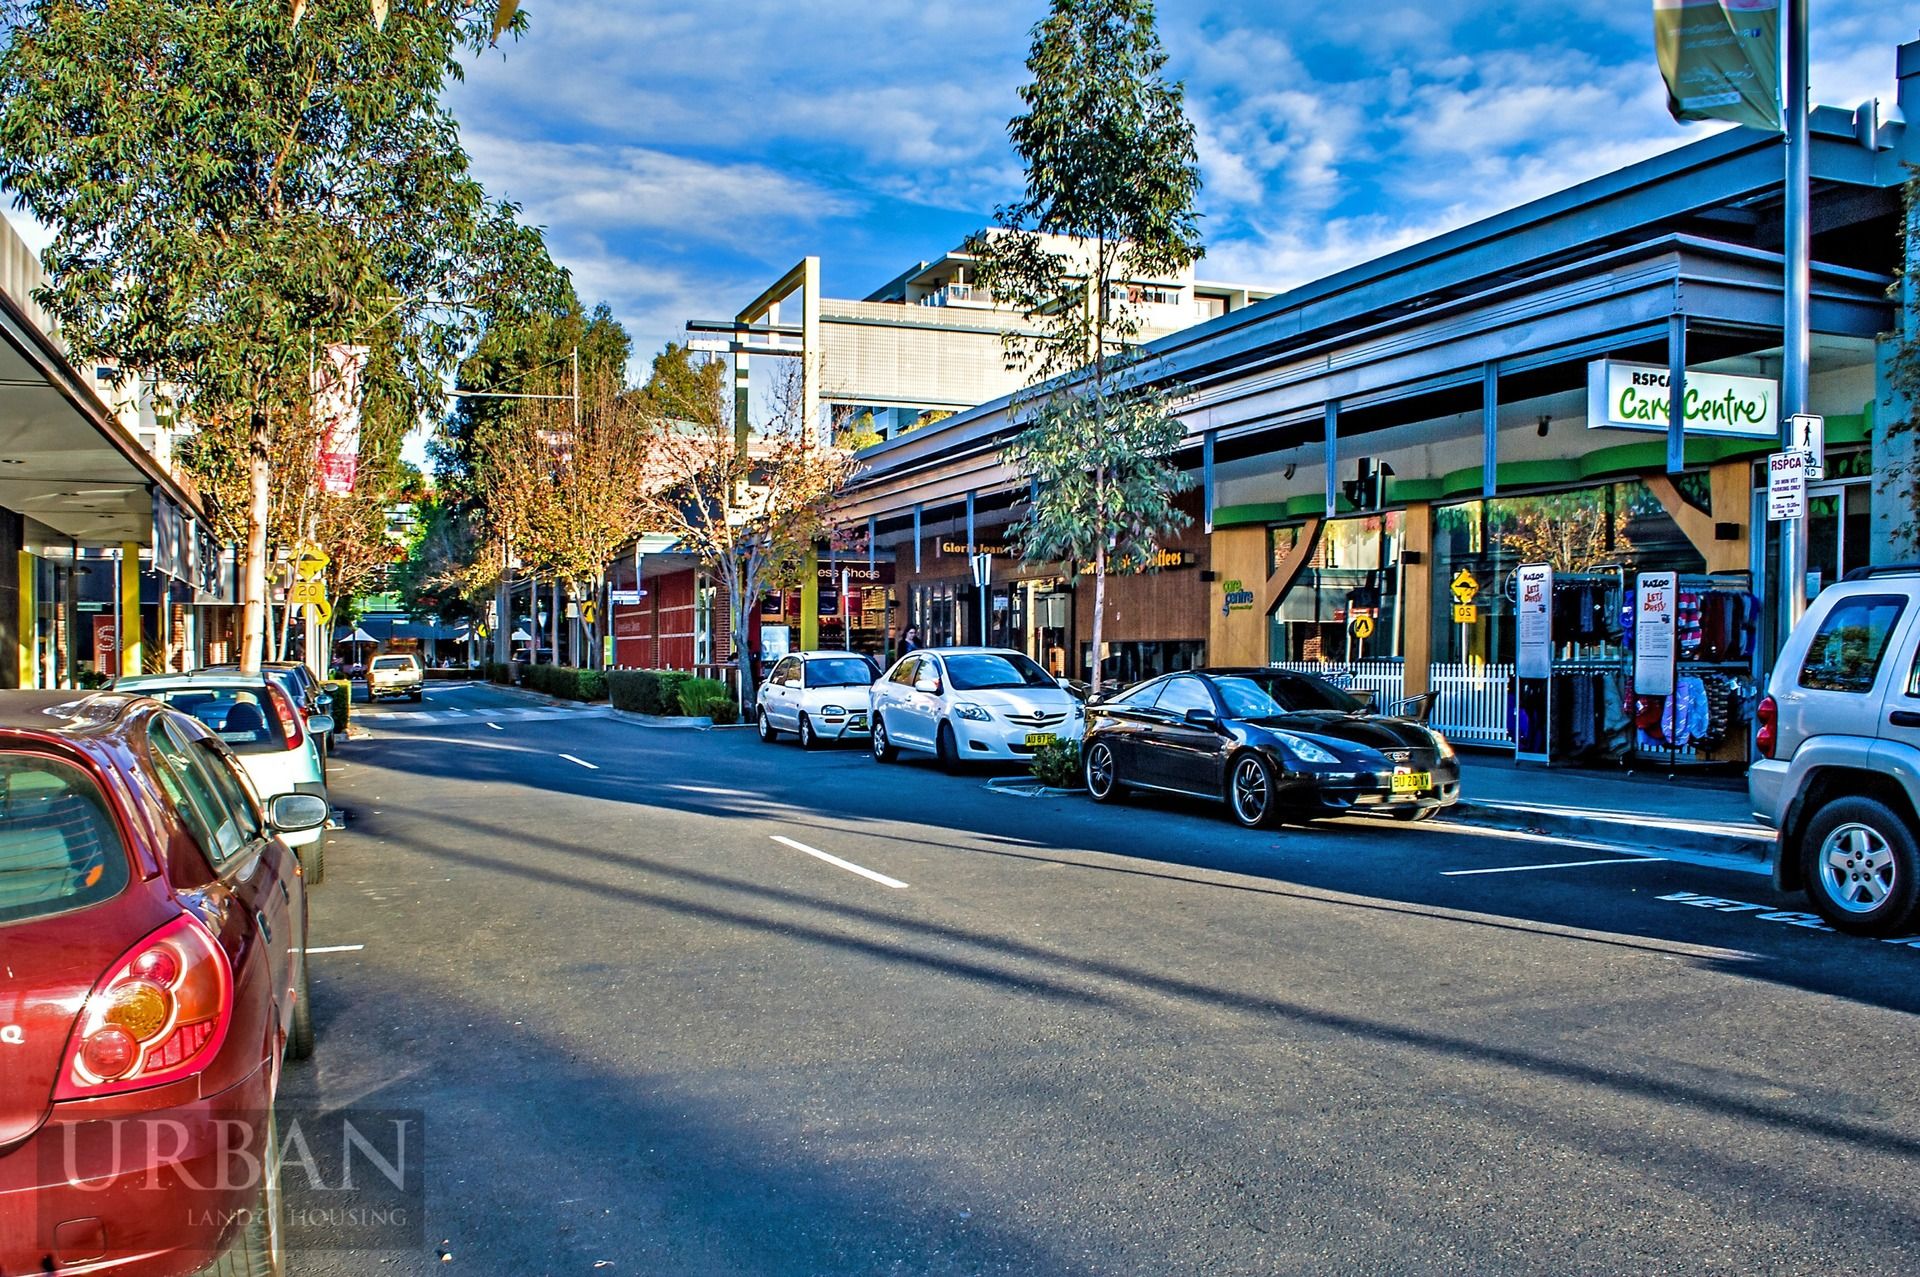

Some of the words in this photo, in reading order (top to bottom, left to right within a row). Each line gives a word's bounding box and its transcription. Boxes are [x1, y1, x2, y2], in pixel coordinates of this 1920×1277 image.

[1619, 387, 1670, 420] Care
[1683, 388, 1768, 426] Centre
[1771, 457, 1801, 471] RSPCA
[1804, 468, 1817, 477] ND
[979, 544, 1006, 554] Jean'
[845, 567, 880, 579] Shoes
[1523, 572, 1545, 581] KAZOO
[1642, 579, 1670, 588] KAZOO
[298, 585, 317, 596] 20
[1653, 891, 1779, 912] VET
